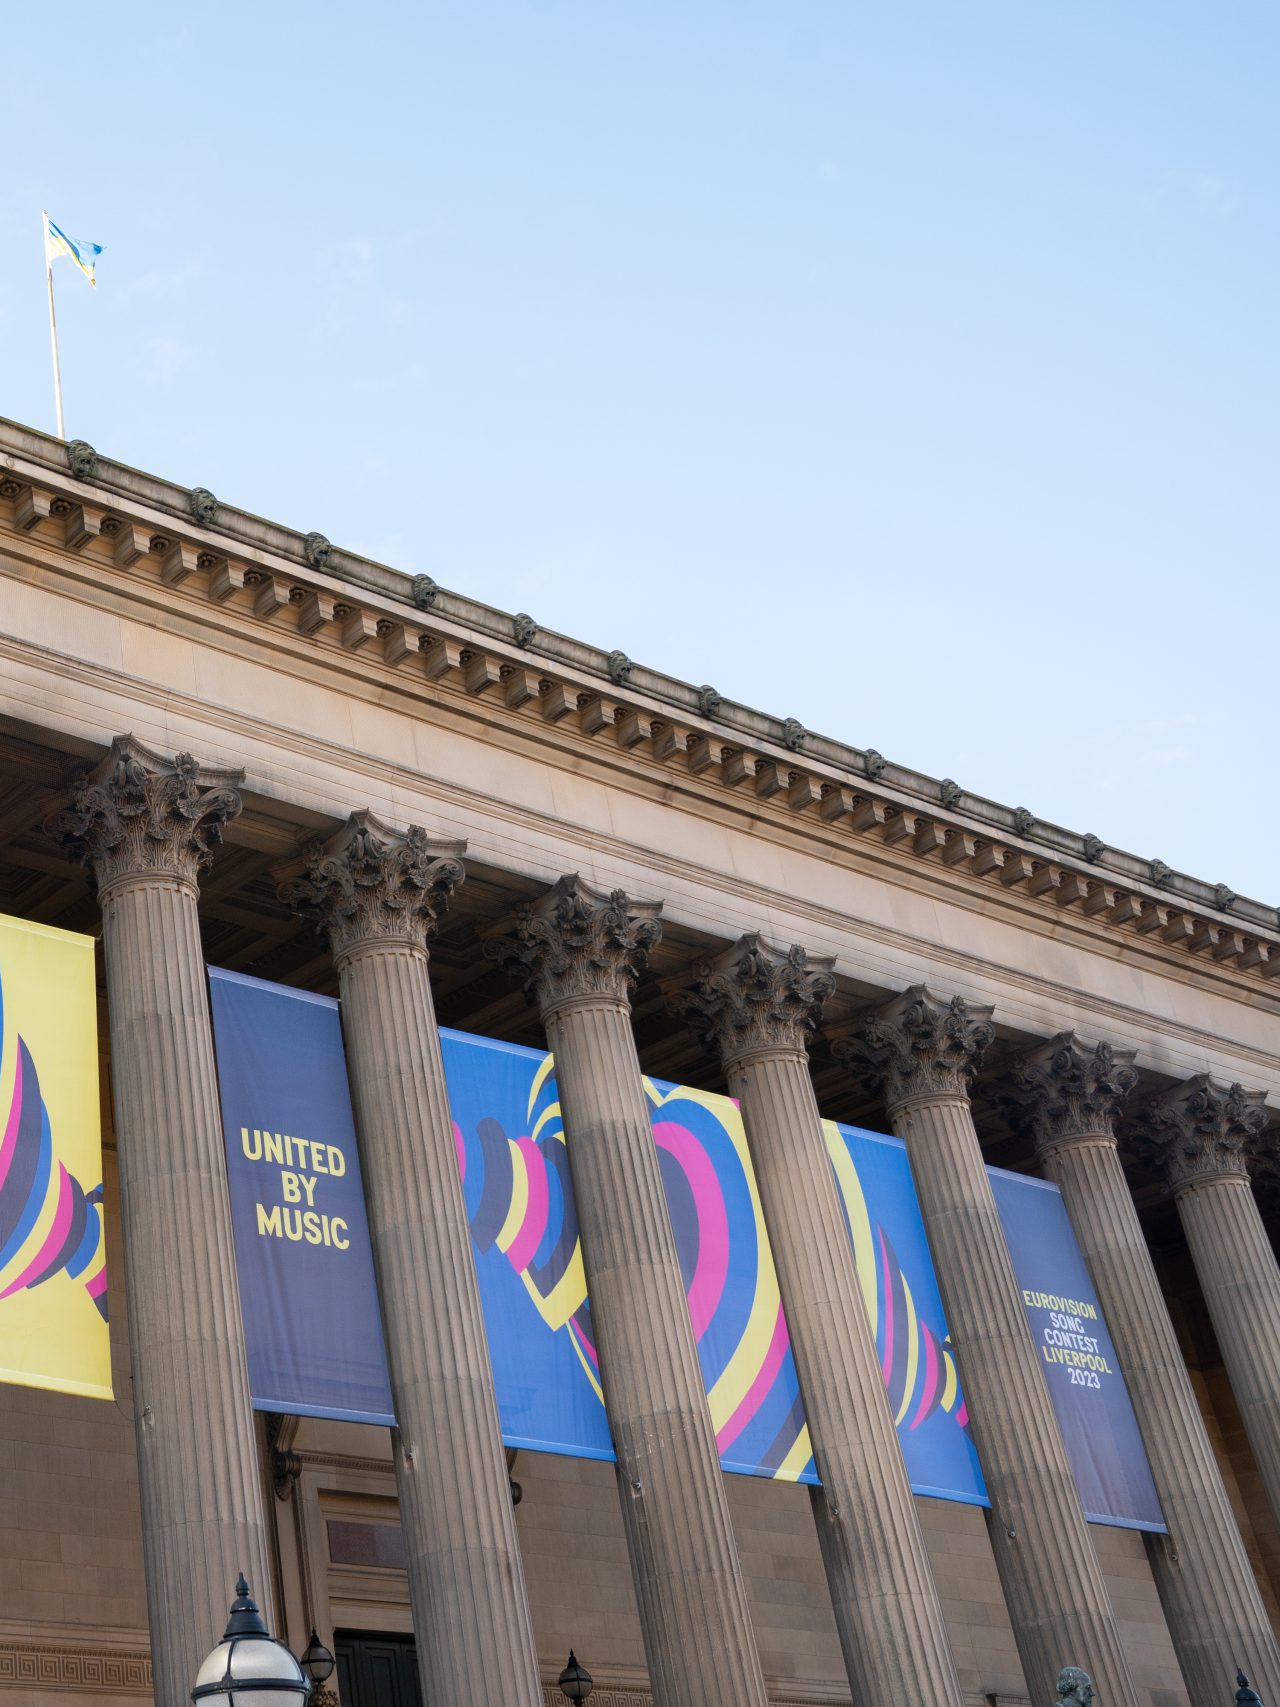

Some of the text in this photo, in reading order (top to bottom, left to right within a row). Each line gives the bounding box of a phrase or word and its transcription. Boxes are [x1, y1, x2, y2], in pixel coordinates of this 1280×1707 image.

[241, 1127, 346, 1177] UNITED
[281, 1170, 318, 1207] BY
[255, 1203, 350, 1250] MUSIC
[1022, 1289, 1098, 1321] EUROVISION
[1049, 1311, 1086, 1334] SONG
[1043, 1328, 1100, 1354] CONTEST
[1042, 1345, 1113, 1375] LIVERPOOL
[1067, 1367, 1101, 1389] 2023
